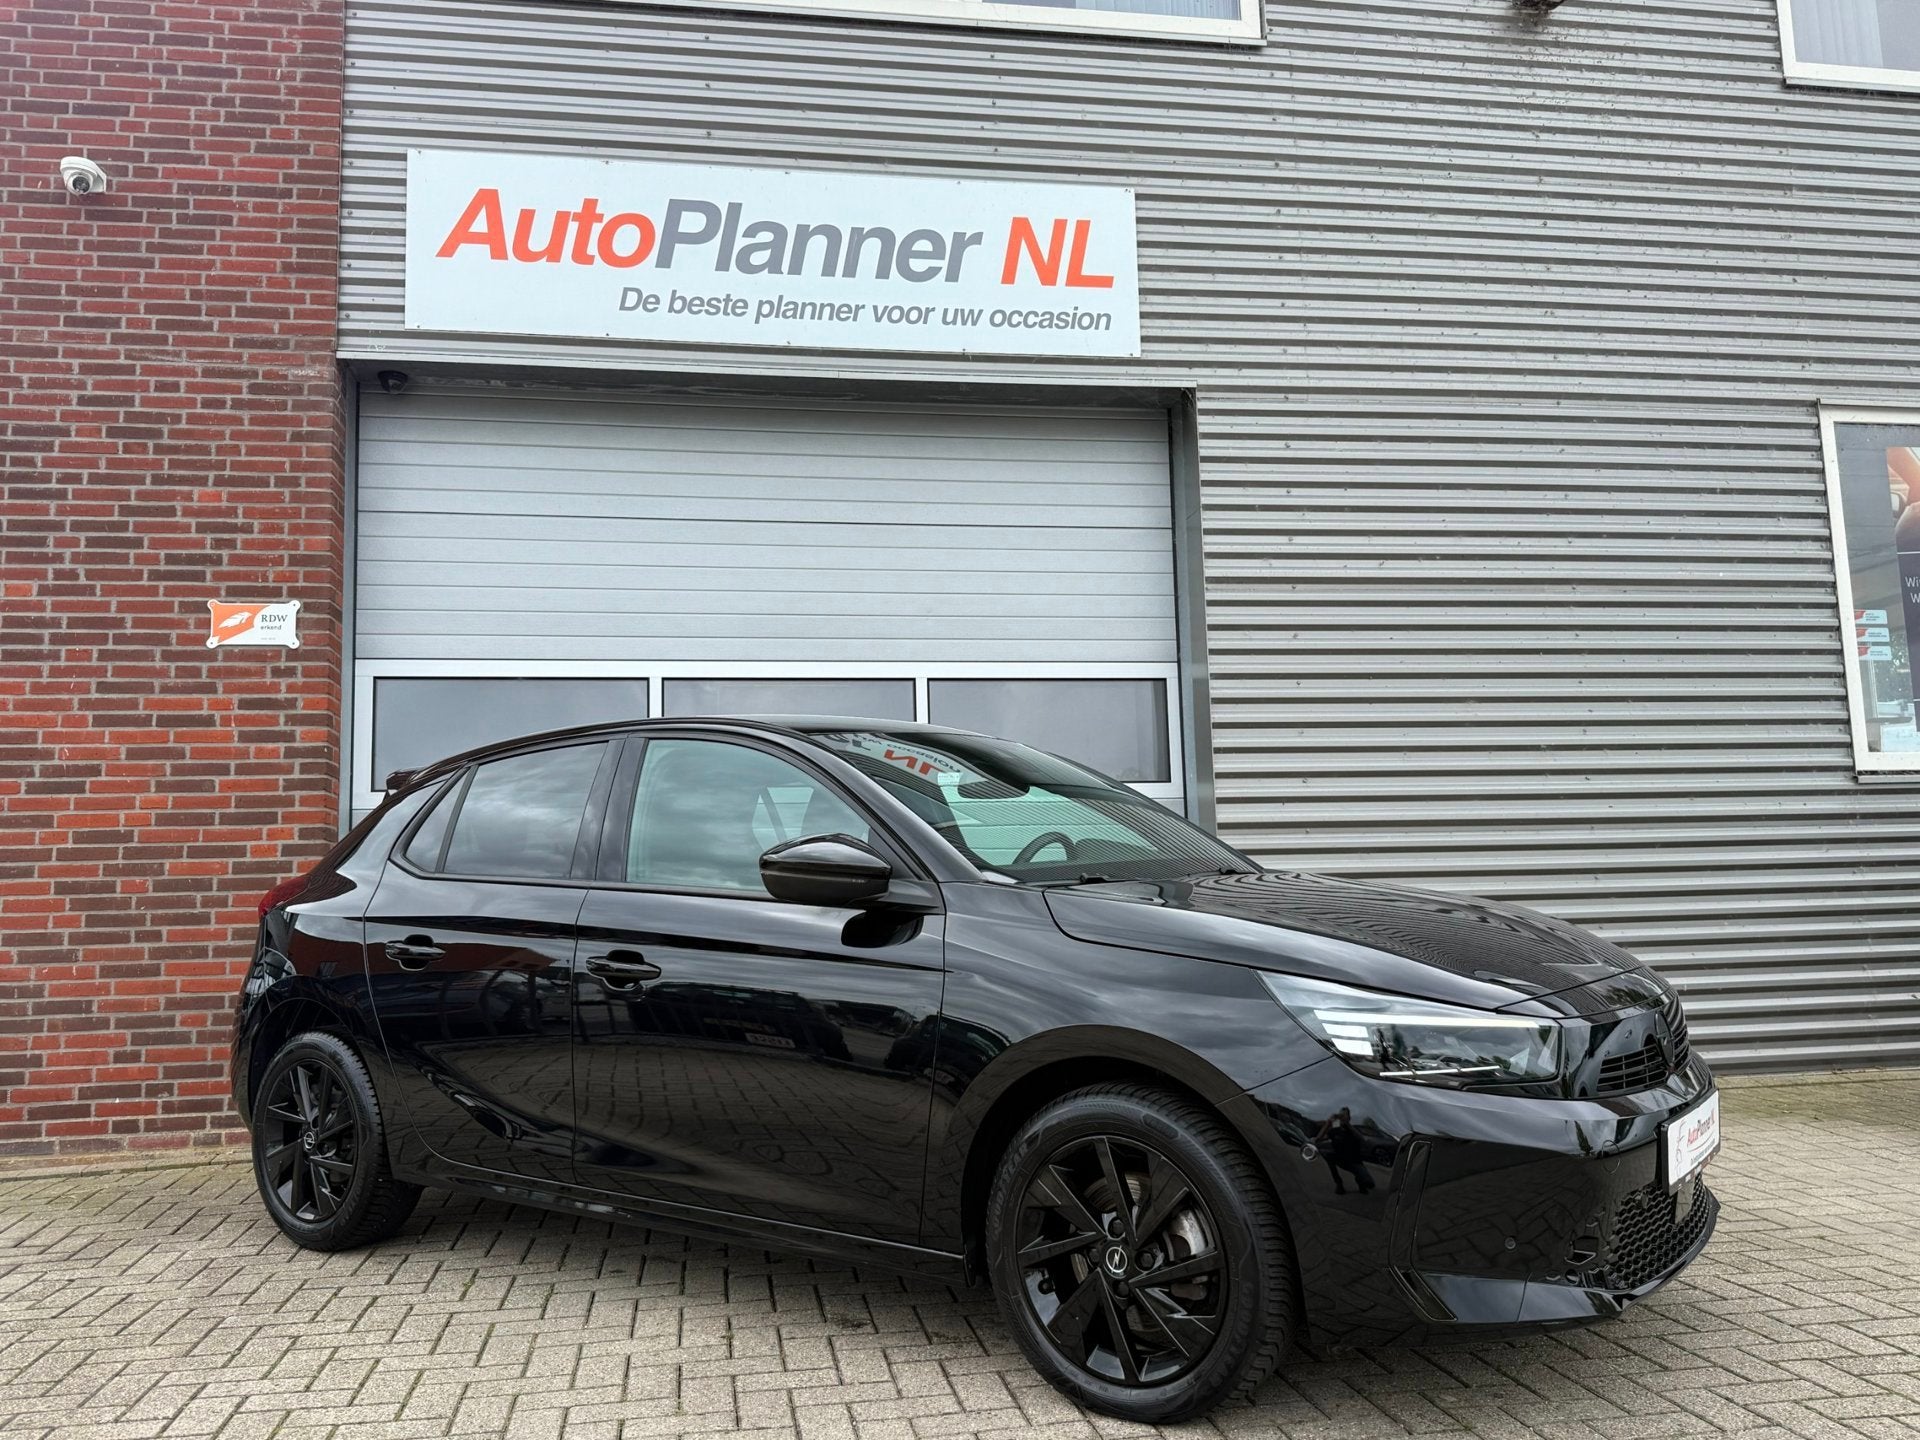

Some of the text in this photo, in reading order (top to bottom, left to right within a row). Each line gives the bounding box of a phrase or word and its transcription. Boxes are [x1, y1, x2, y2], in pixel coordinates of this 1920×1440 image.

[436, 187, 1115, 289] AutoPlanner NL
[618, 286, 1113, 332] De beste planner voor uw occasion
[1905, 576, 1920, 588] Wi
[261, 614, 288, 622] RDW
